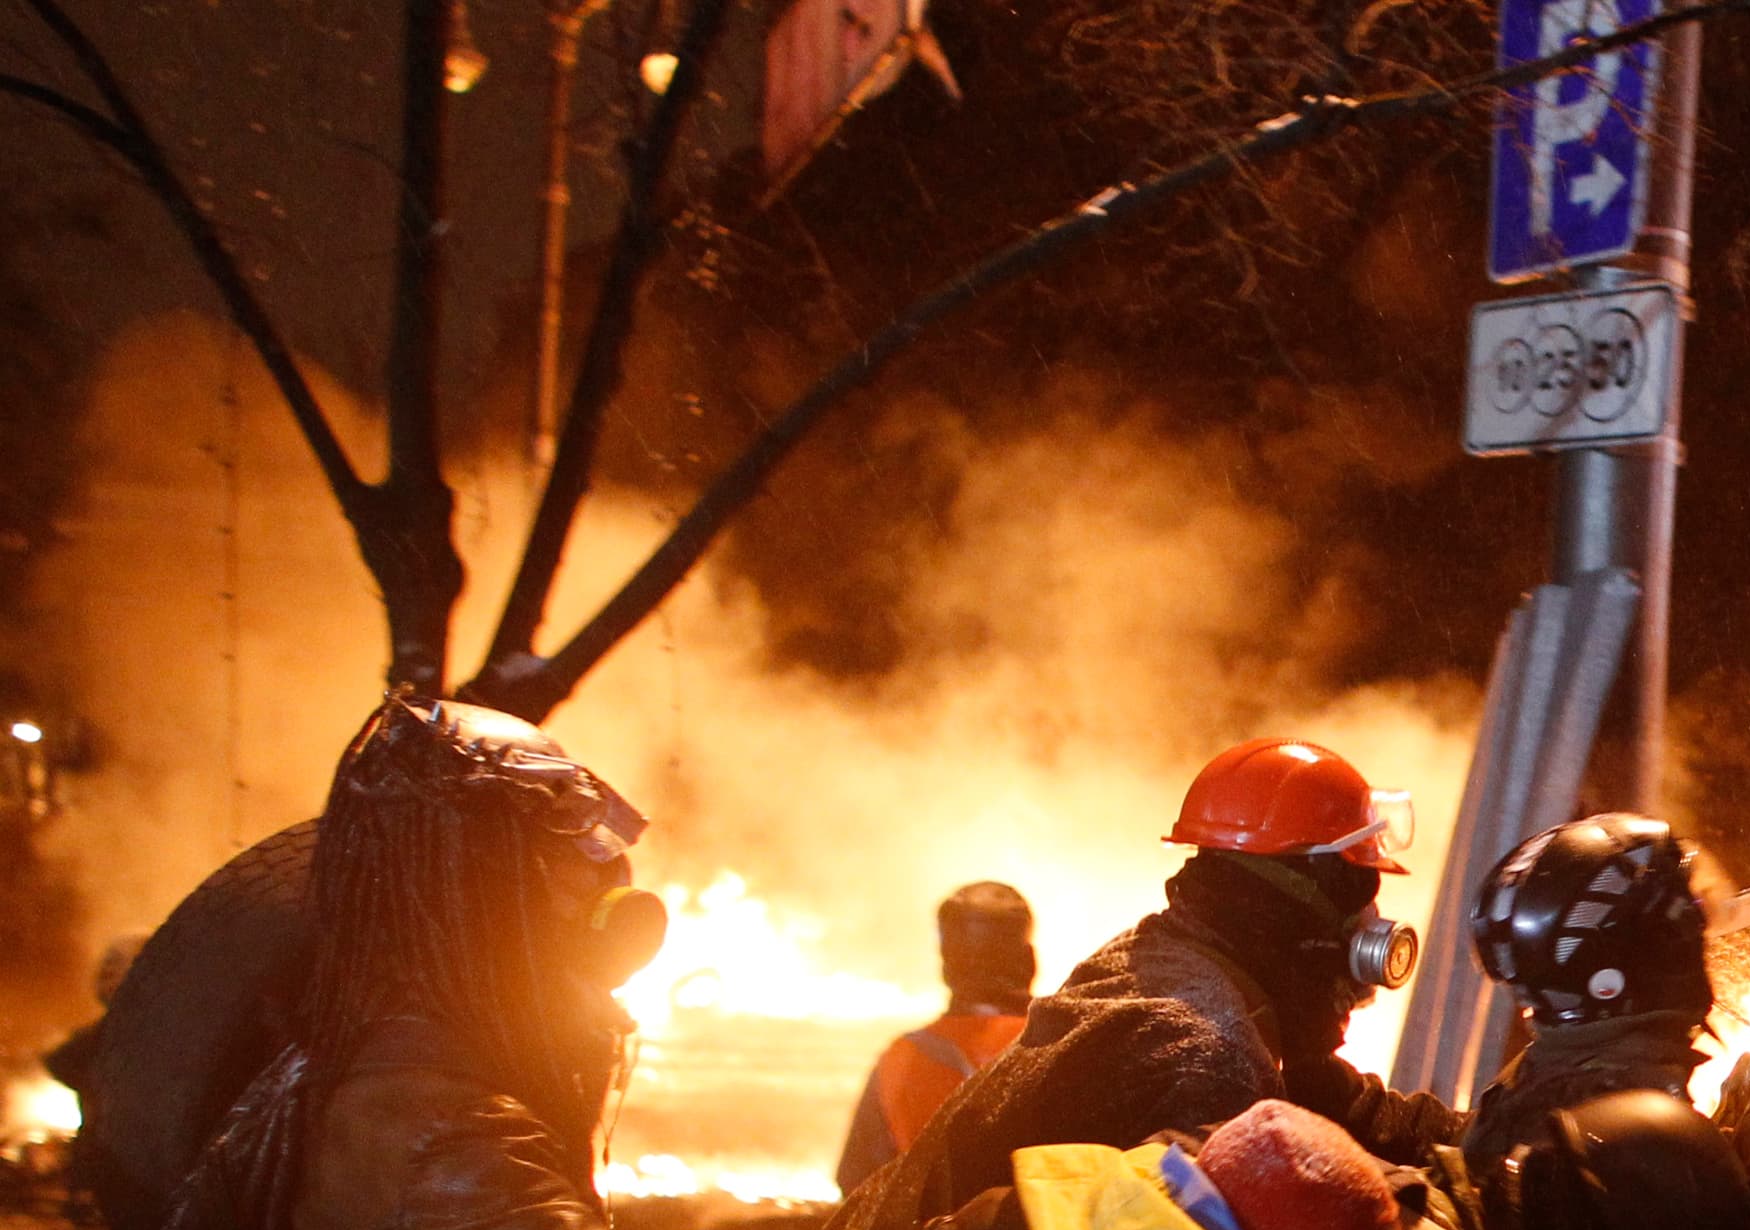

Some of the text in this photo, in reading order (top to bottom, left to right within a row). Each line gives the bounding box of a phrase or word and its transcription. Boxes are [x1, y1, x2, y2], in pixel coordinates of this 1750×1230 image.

[1530, 0, 1622, 237] P
[1537, 350, 1577, 390] 25
[1588, 339, 1634, 391] 50
